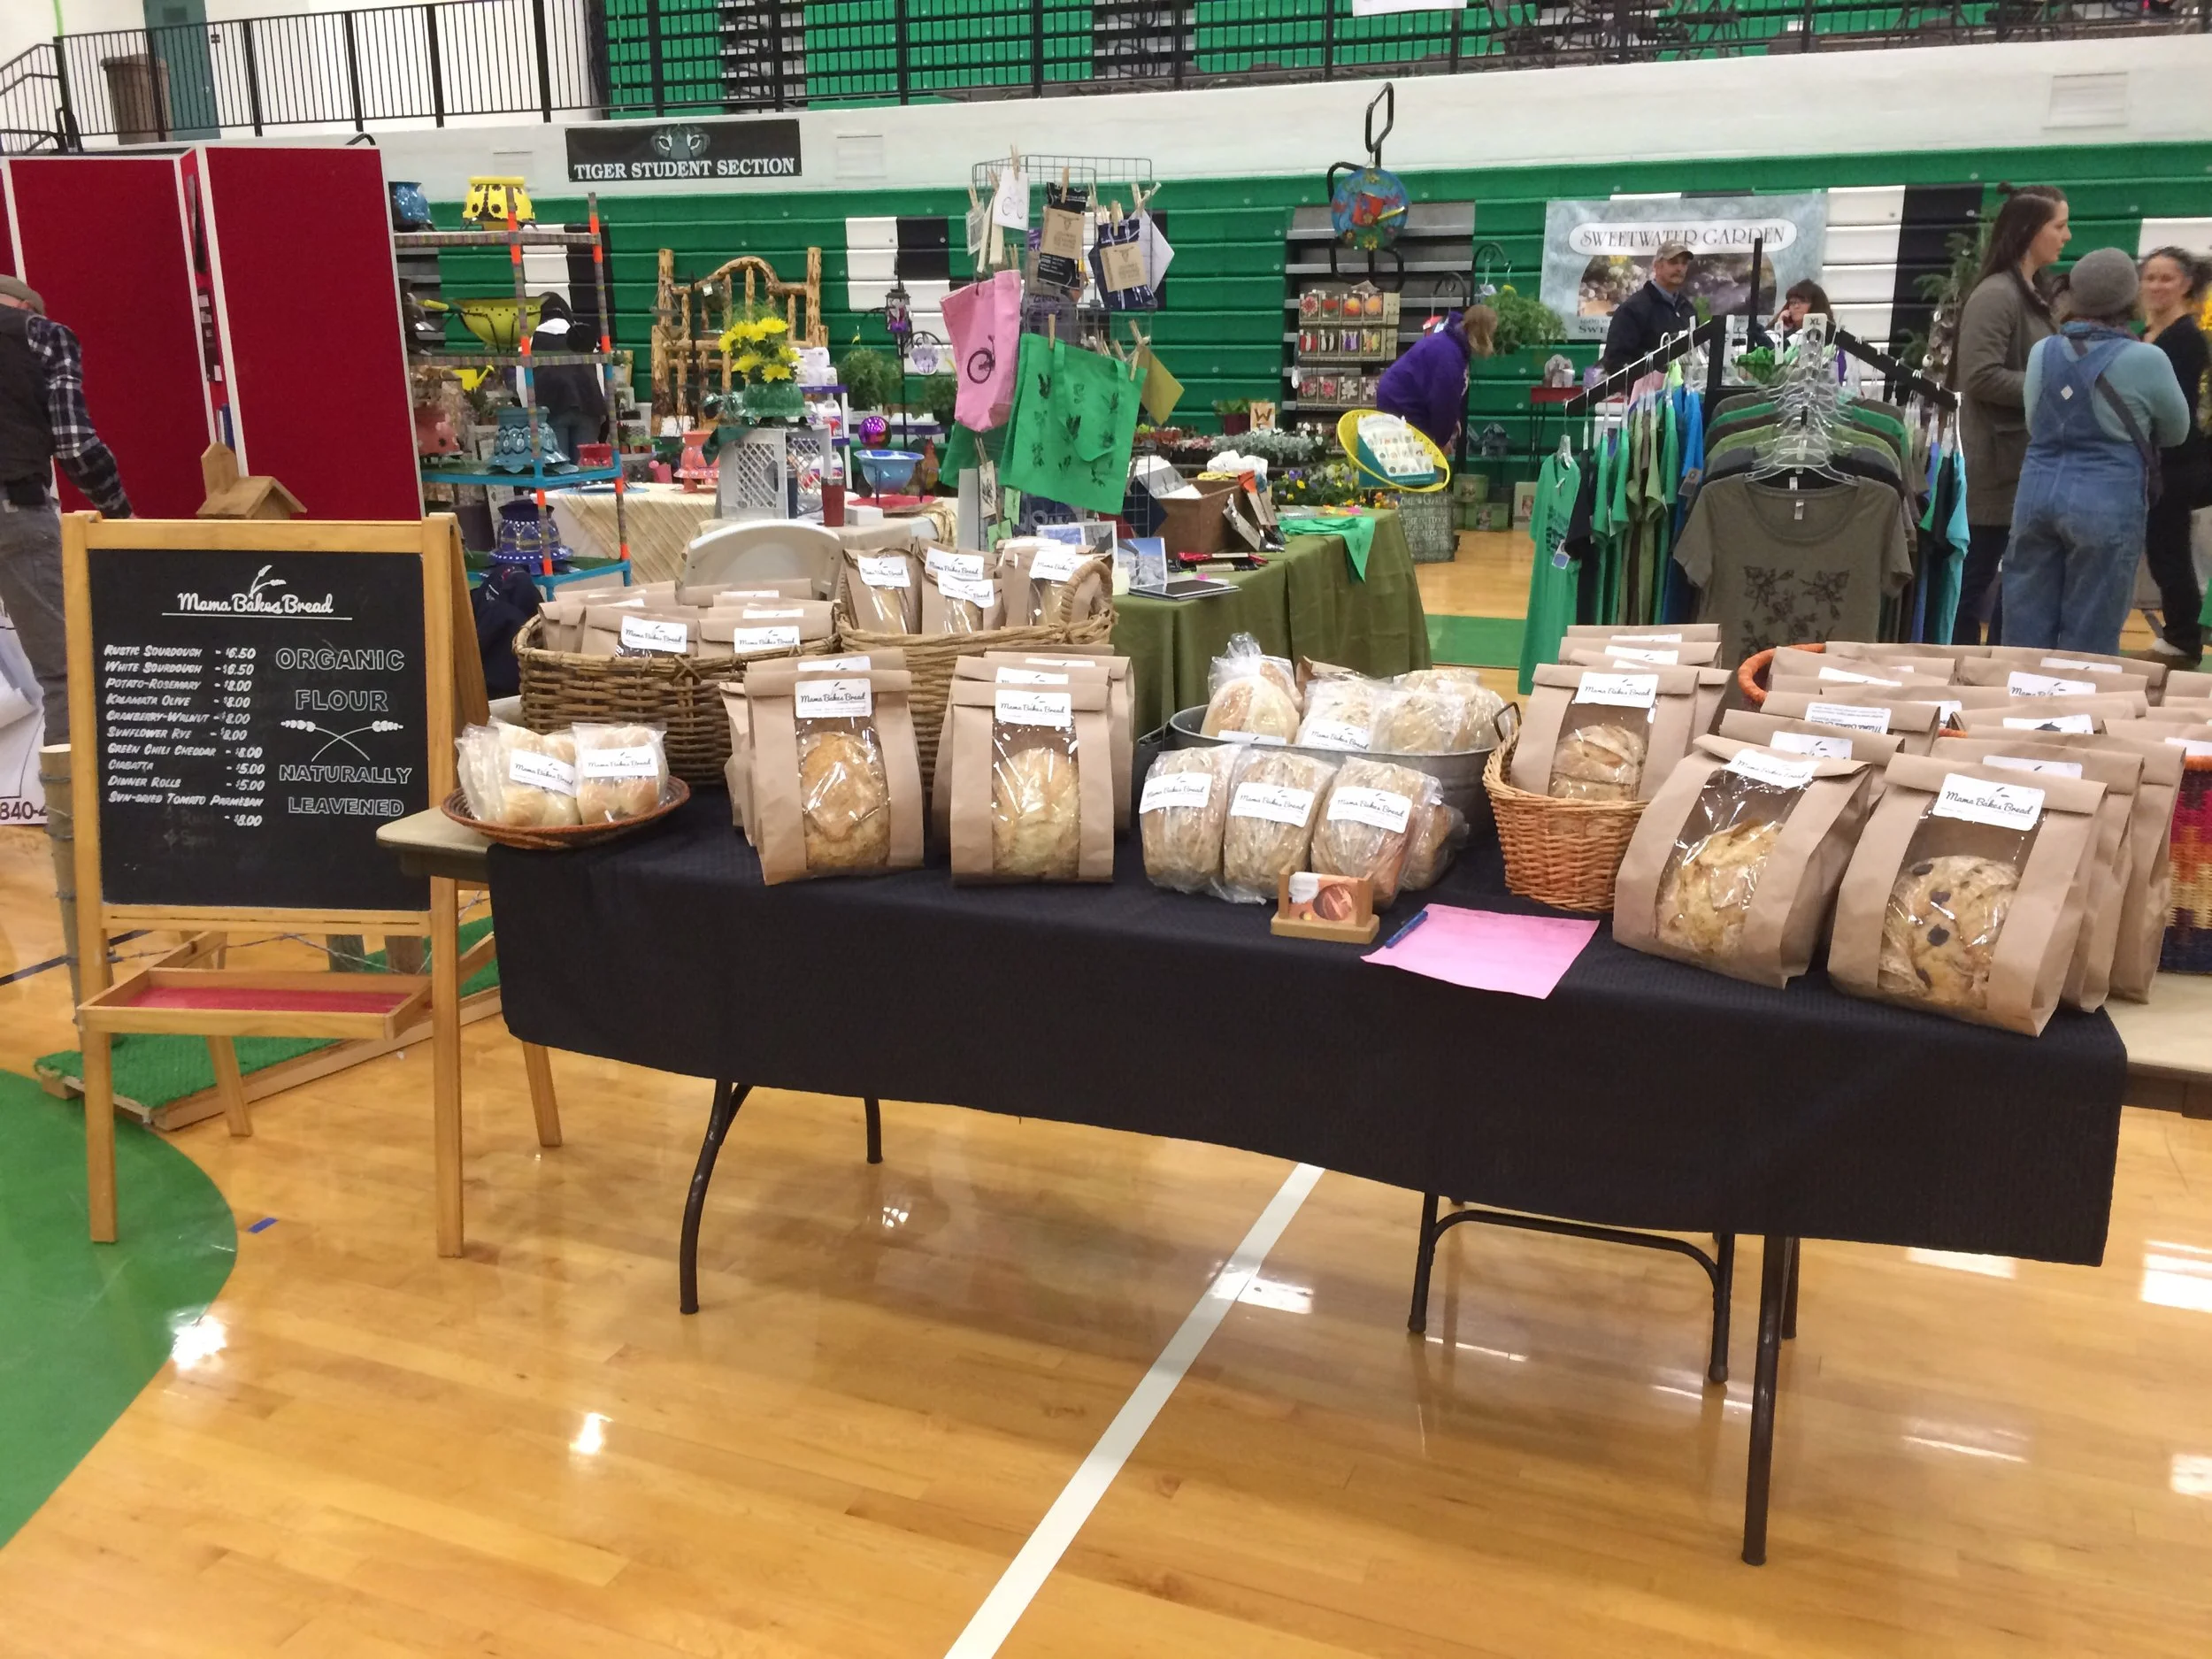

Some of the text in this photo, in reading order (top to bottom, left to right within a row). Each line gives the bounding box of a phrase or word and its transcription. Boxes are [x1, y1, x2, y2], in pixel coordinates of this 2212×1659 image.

[574, 157, 795, 180] TIGER STUDENT SECTION
[1579, 226, 1786, 248] SWEETWATER GARDEN
[177, 593, 334, 614] Mama Bakes Bread
[104, 644, 257, 660] RUSTIC SOURDOUGH $6.50
[275, 648, 405, 672] ORGANIC
[104, 660, 255, 676] WHITE SOURDOUGH $6.50
[224, 680, 252, 692] $8.00
[106, 694, 251, 708] KALAMATA OLIVE $8.00
[295, 688, 389, 712] FLOUR
[844, 692, 865, 701] Bread
[221, 711, 251, 725] $8.00
[106, 726, 168, 740] SUNFLOWER
[172, 727, 193, 740] RYE
[108, 742, 264, 759] GREEN CHILI CHEDDAR $8.00
[108, 759, 265, 775] CIABATTA $5.00
[279, 764, 413, 785] NATURALLY
[108, 775, 265, 791] DINNER ROLLS $5.00
[108, 791, 264, 807] SUN-DRIED TOMATO PARMESAN
[288, 796, 405, 818] LEAVENED
[1947, 791, 1974, 805] Mama
[1976, 797, 2001, 810] Bakes
[2004, 802, 2033, 815] Bread
[234, 814, 264, 827] $8.00
